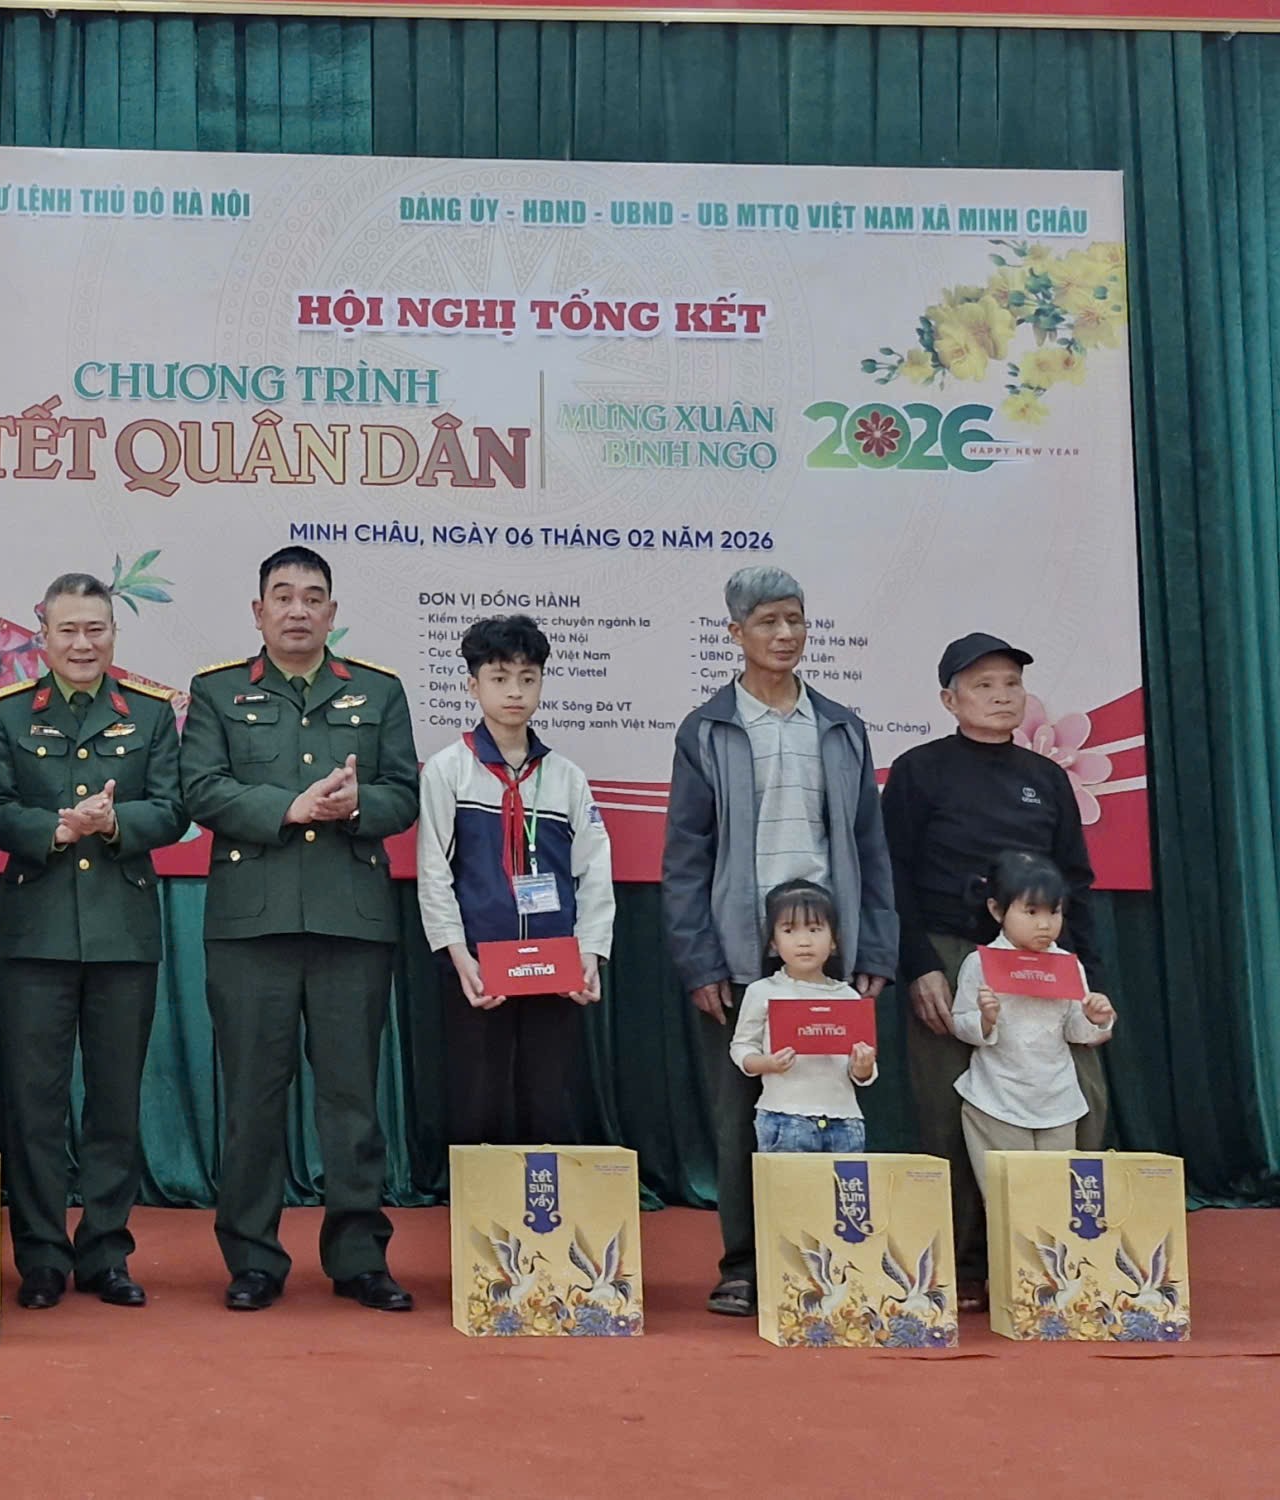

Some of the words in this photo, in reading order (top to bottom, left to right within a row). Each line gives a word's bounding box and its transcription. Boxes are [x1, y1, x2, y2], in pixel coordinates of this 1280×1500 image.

[17, 184, 72, 216] LỆNH
[80, 184, 122, 214] THỦ
[133, 187, 165, 215] ĐÔ
[173, 188, 203, 216] HÀ
[211, 189, 250, 221] NỘI
[400, 191, 461, 221] ĐẢNG
[470, 192, 499, 222] ỦY
[523, 200, 586, 223] HĐND
[611, 201, 673, 225] UBND
[697, 202, 728, 226] UB
[736, 203, 799, 230] MTTQ
[808, 201, 856, 233] VIỆT
[864, 206, 914, 230] NAM
[921, 204, 951, 231] XÃ
[958, 207, 1018, 232] MINH
[1026, 205, 1088, 233] CHÂU
[298, 289, 384, 333] HỘI
[397, 298, 517, 336] NGHỊ
[530, 288, 660, 333] TỔNG
[674, 292, 767, 333] KẾT
[74, 361, 286, 403] CHƯƠNG
[296, 359, 440, 404] TRÌNH
[560, 398, 666, 433] MỪNG
[674, 400, 775, 433] XUÂN
[114, 408, 351, 496] QUÂN
[360, 411, 532, 489] DÂN
[606, 434, 691, 467] BÍNH
[697, 441, 777, 474] NGỌ
[970, 447, 1010, 455] HAPPY
[1016, 447, 1042, 455] NEW
[1048, 448, 1080, 457] YEAR
[290, 523, 347, 541] MINH
[354, 520, 425, 546] CHÂU,
[432, 521, 498, 545] NGÀY
[505, 527, 533, 546] 06
[540, 524, 621, 548] THÁNG
[628, 529, 655, 548] 02
[662, 526, 713, 548] NĂM
[720, 531, 774, 549] 2026
[418, 592, 456, 606] ĐƠN
[460, 593, 476, 610] VỊ
[536, 592, 581, 608] HÀNH
[551, 615, 595, 628] chuyên
[598, 616, 636, 630] ngành
[428, 630, 448, 643] Hội
[550, 632, 566, 643] Hà
[569, 633, 589, 646] Nội
[700, 633, 719, 647] Hội
[829, 636, 846, 647] Hà
[849, 636, 869, 650] Nội
[556, 650, 580, 661] Việt
[583, 650, 611, 661] Nam
[700, 651, 734, 661] UBND
[811, 652, 836, 663] Liên
[568, 666, 608, 678] Viettel
[700, 667, 729, 680] Cụm
[805, 669, 821, 680] TP
[823, 669, 840, 680] Hà
[843, 670, 863, 683] Nội
[428, 682, 457, 694] Điện
[428, 698, 462, 711] Công
[465, 699, 477, 711] ty
[562, 700, 593, 714] Sông
[616, 701, 633, 712] VT
[428, 714, 462, 728] Công
[465, 716, 477, 728] ty
[552, 718, 586, 731] lượng
[589, 719, 619, 729] xanh
[620, 718, 645, 731] Việt
[648, 719, 676, 730] Nam
[528, 1183, 555, 1193] sum
